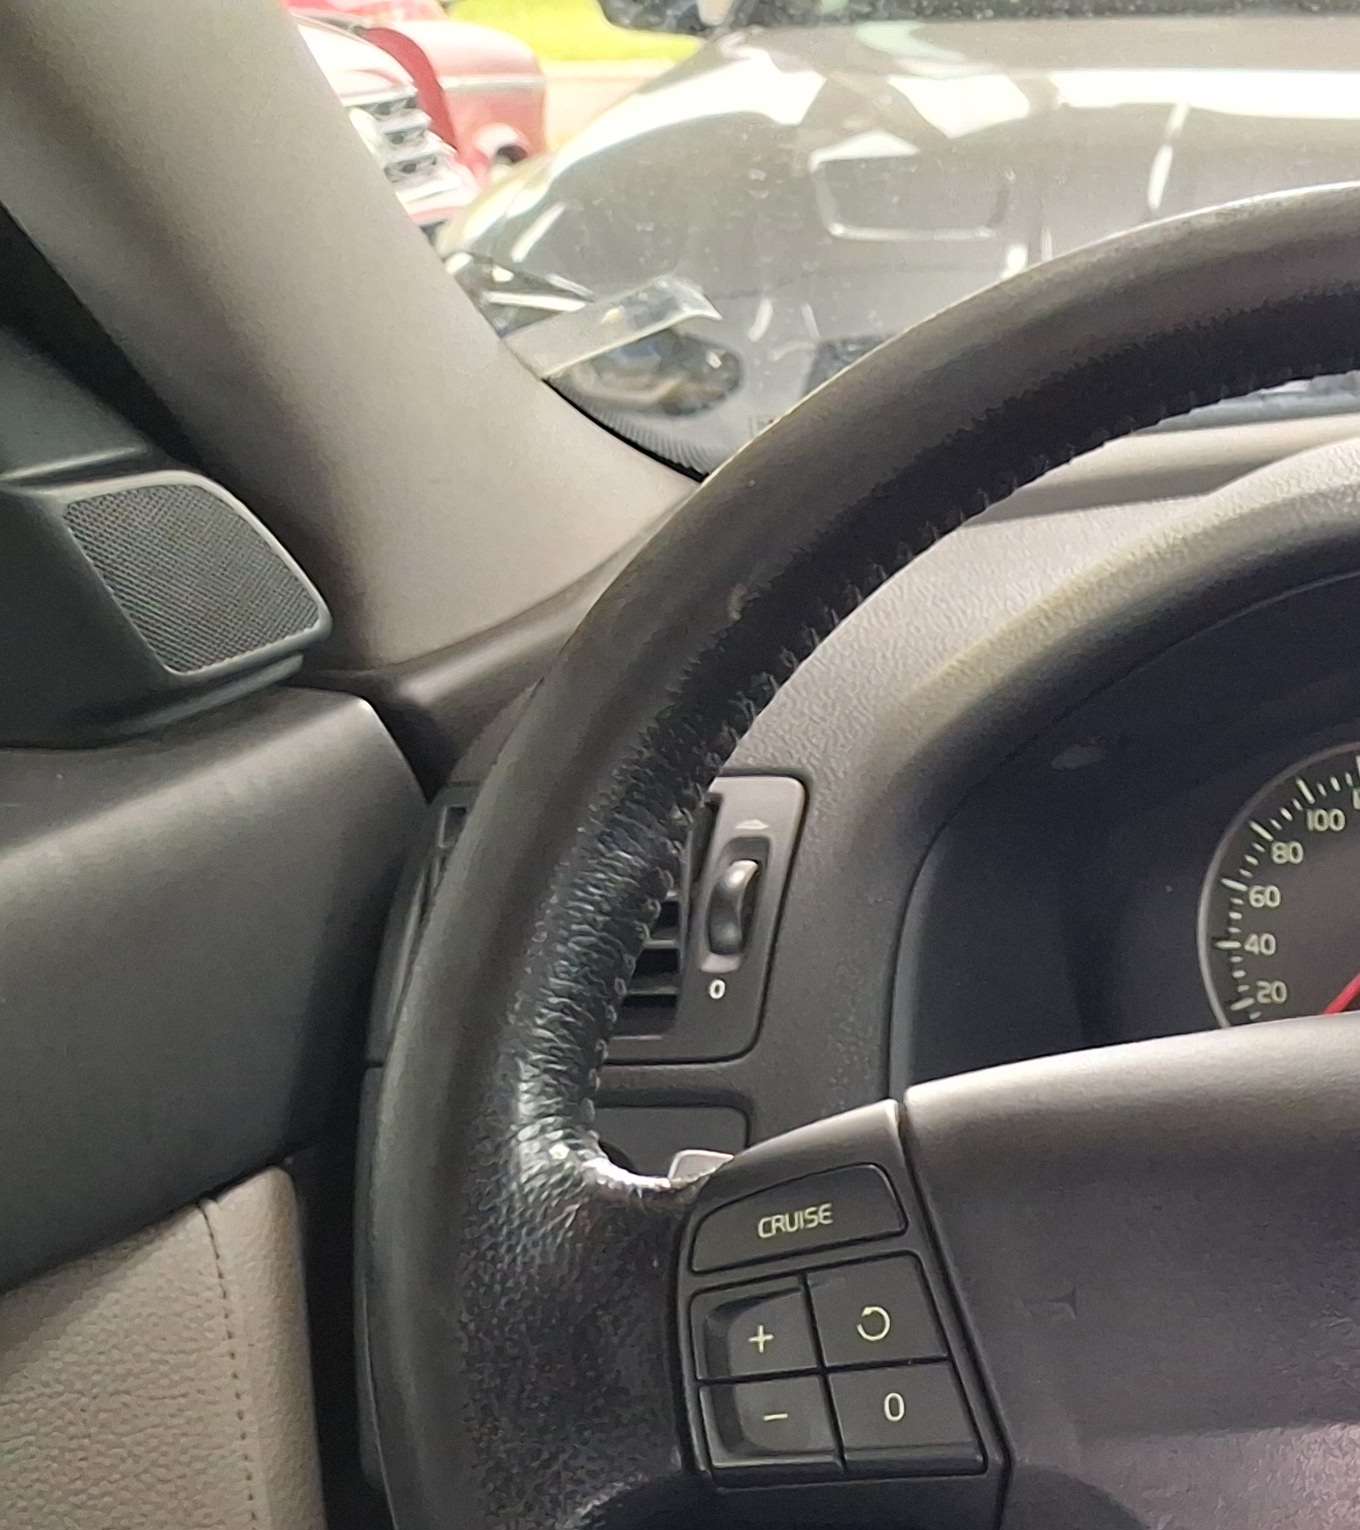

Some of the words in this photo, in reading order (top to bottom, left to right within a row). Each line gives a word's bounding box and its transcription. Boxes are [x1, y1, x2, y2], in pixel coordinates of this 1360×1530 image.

[1307, 810, 1345, 831] 100
[1271, 842, 1304, 864] 80
[1249, 886, 1281, 908] 60
[1243, 934, 1276, 956] 40
[1256, 981, 1288, 1004] 20
[758, 1203, 833, 1238] CRUISE
